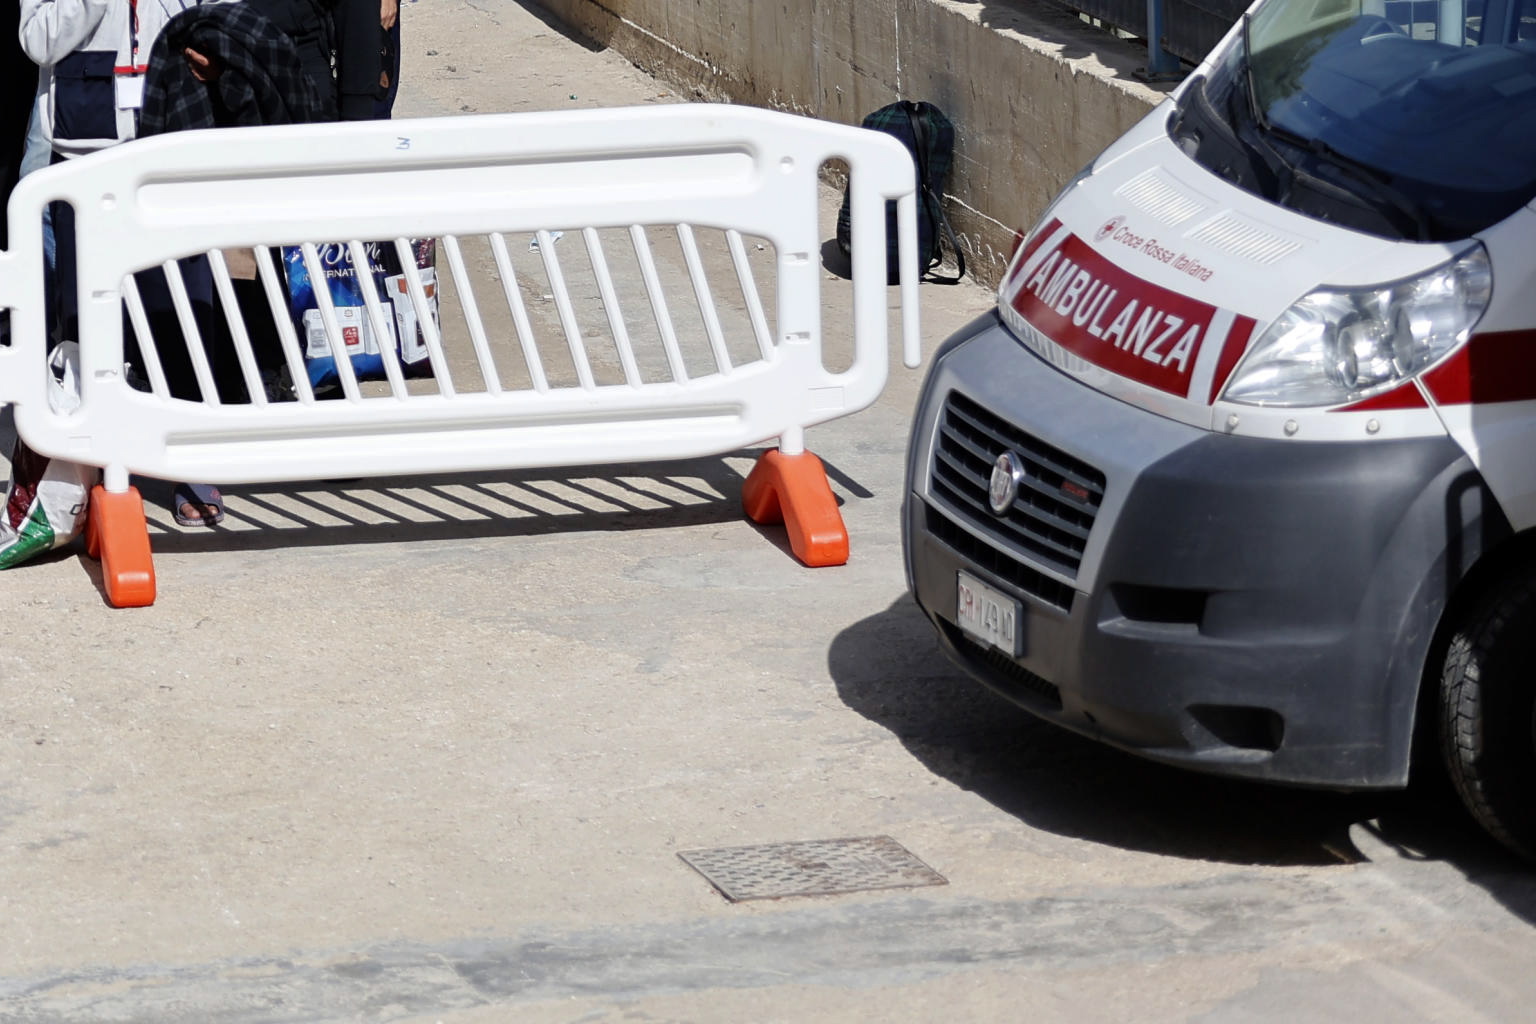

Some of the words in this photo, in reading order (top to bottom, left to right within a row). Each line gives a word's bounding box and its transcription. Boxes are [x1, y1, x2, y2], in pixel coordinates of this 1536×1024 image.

[1112, 226, 1147, 250] Croce
[1141, 238, 1176, 264] Rossa
[1171, 252, 1214, 282] Italiana
[1026, 249, 1201, 373] AMBULANZA
